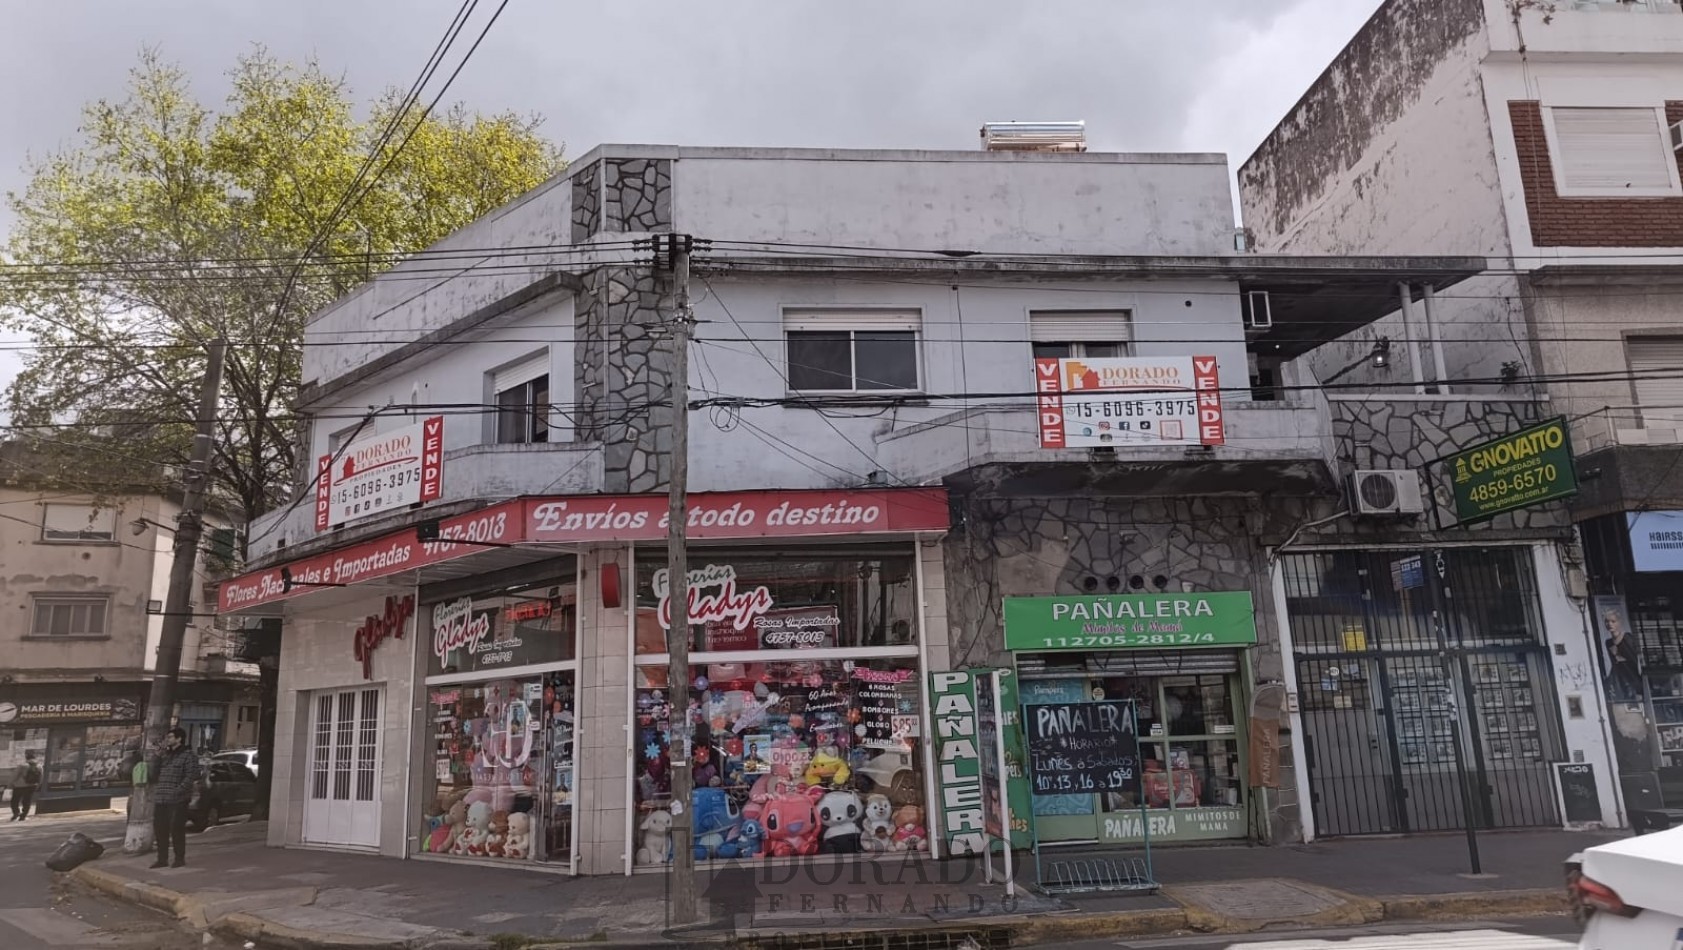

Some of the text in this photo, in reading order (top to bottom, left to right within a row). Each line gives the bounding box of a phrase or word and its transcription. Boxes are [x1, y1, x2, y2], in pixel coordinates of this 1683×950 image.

[1102, 367, 1178, 380] DORADO
[1038, 363, 1061, 443] VENDE
[1076, 400, 1195, 417] 15-6096-3975
[1195, 361, 1221, 439] VENDE
[356, 435, 411, 464] DORADO
[424, 422, 439, 496] VENDE
[1470, 426, 1563, 473] GNOVATTO
[1469, 463, 1557, 503] 4859-6570
[1493, 457, 1541, 478] PROPIEDADES
[318, 459, 330, 526] VENDE
[337, 467, 420, 504] 15-6096-3975
[533, 501, 648, 531] Envíos
[688, 503, 754, 528] todo
[766, 501, 880, 526] destino
[226, 583, 257, 607] Flores
[258, 567, 320, 600] Nacinales
[323, 568, 331, 582] e
[333, 545, 411, 589] Importadas
[657, 566, 731, 593] Frerías
[753, 617, 783, 628] Rosas
[1053, 598, 1214, 620] PAÑALERA
[435, 611, 488, 668] Gladys
[1043, 633, 1215, 647] 112705-2812/4
[21, 703, 112, 713] MAR DE LOURDES
[1037, 705, 1134, 738] PAÑALERA
[932, 671, 984, 855] PAÑALERA
[1200, 821, 1228, 831] MAMA
